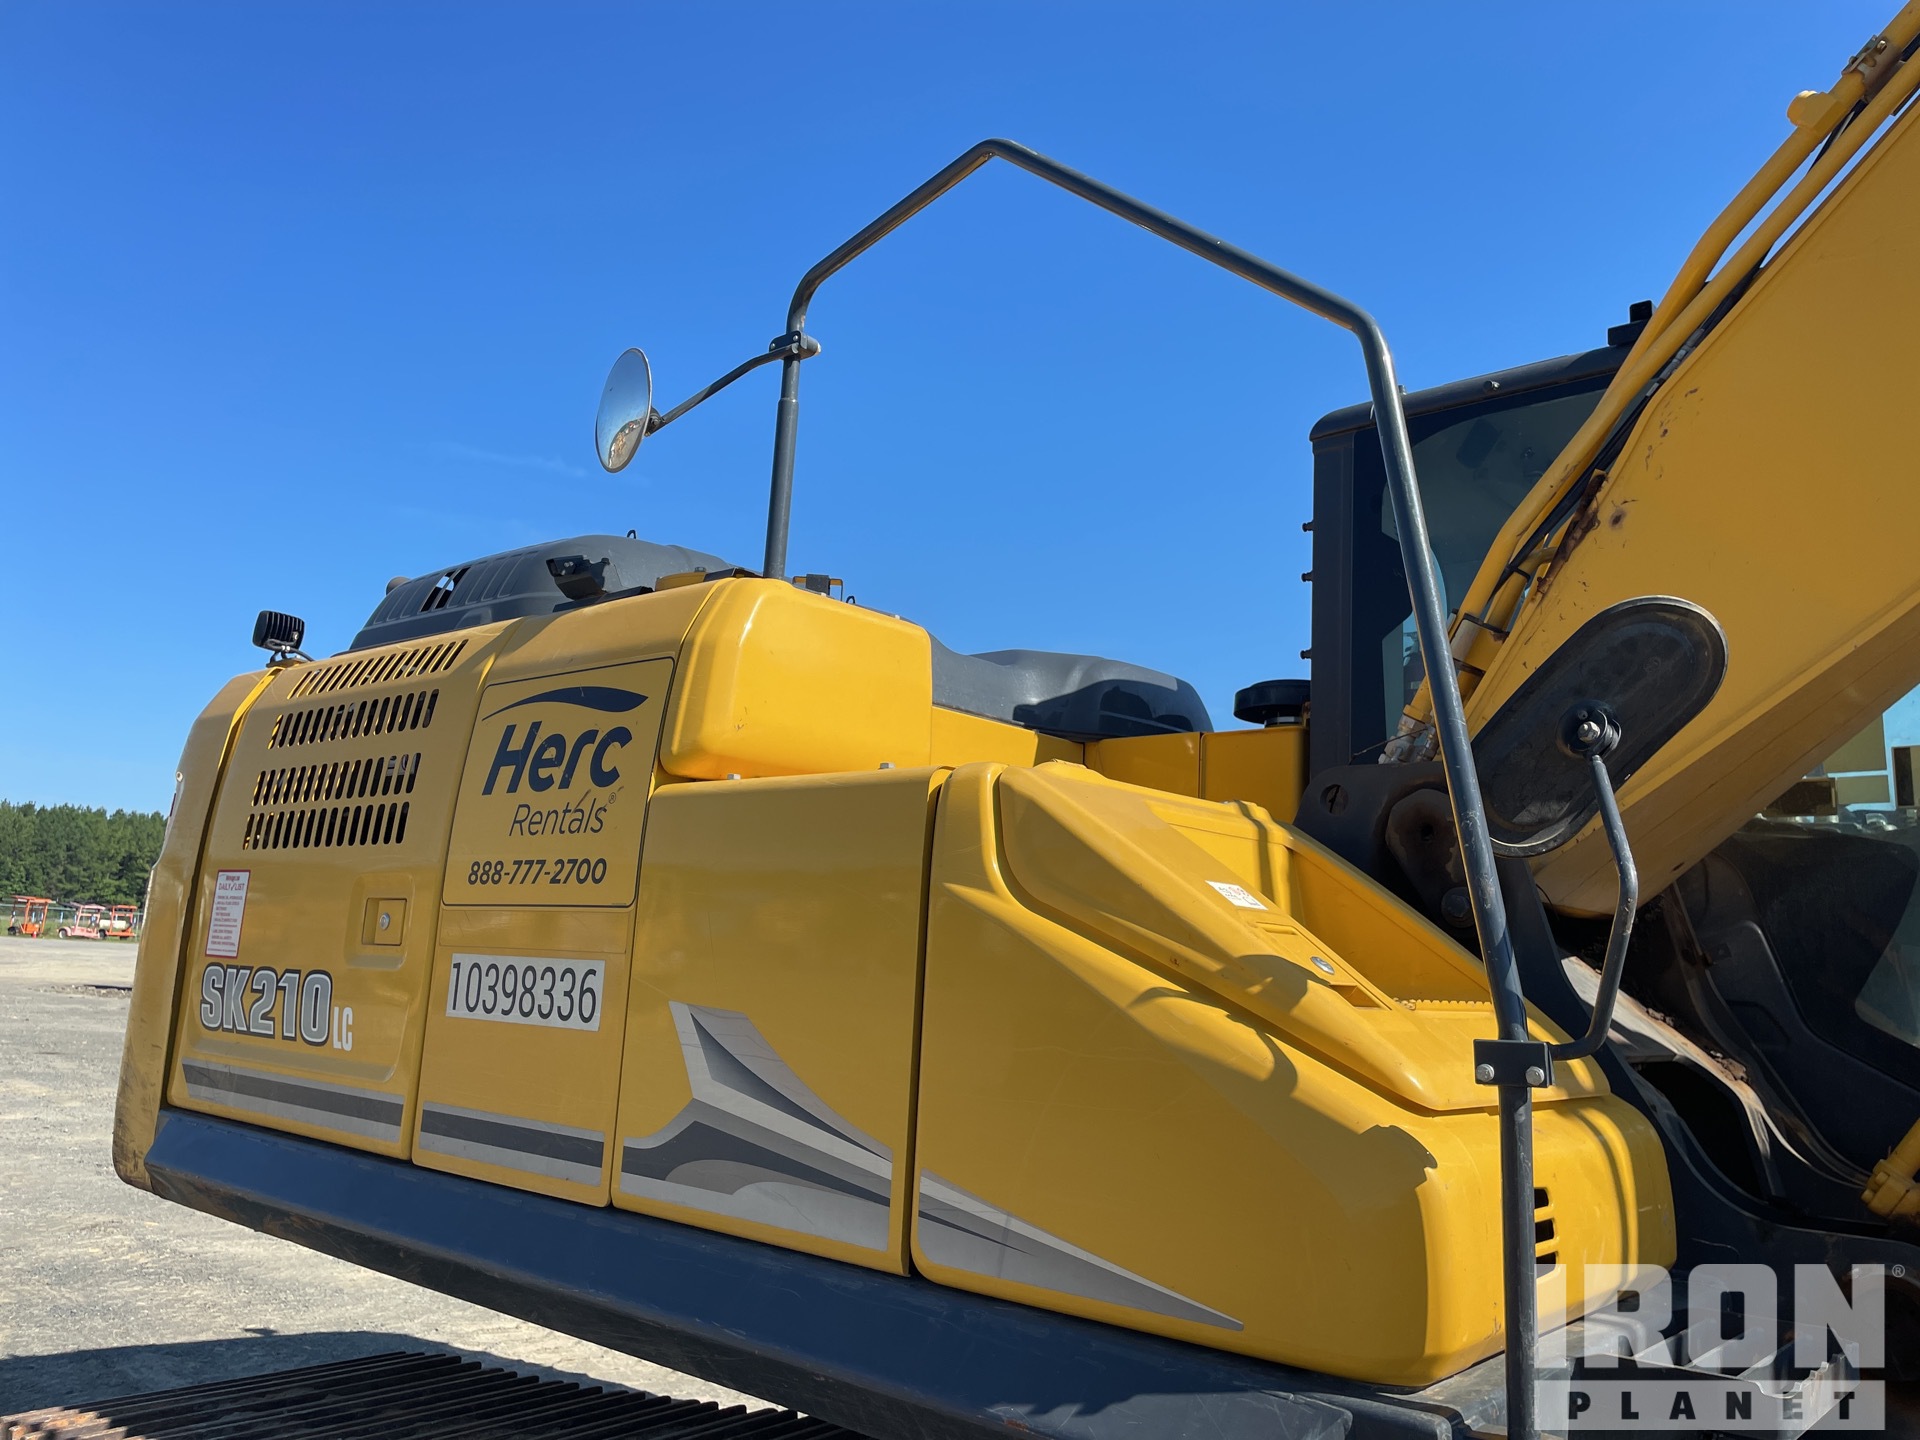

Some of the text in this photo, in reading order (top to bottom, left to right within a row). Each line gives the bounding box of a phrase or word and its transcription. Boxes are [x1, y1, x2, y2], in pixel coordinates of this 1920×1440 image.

[481, 720, 633, 796] Herc
[508, 797, 608, 837] Rentals
[467, 858, 607, 885] 888-777-2700
[199, 962, 353, 1052] SK210 LC
[451, 961, 598, 1024] 10398336
